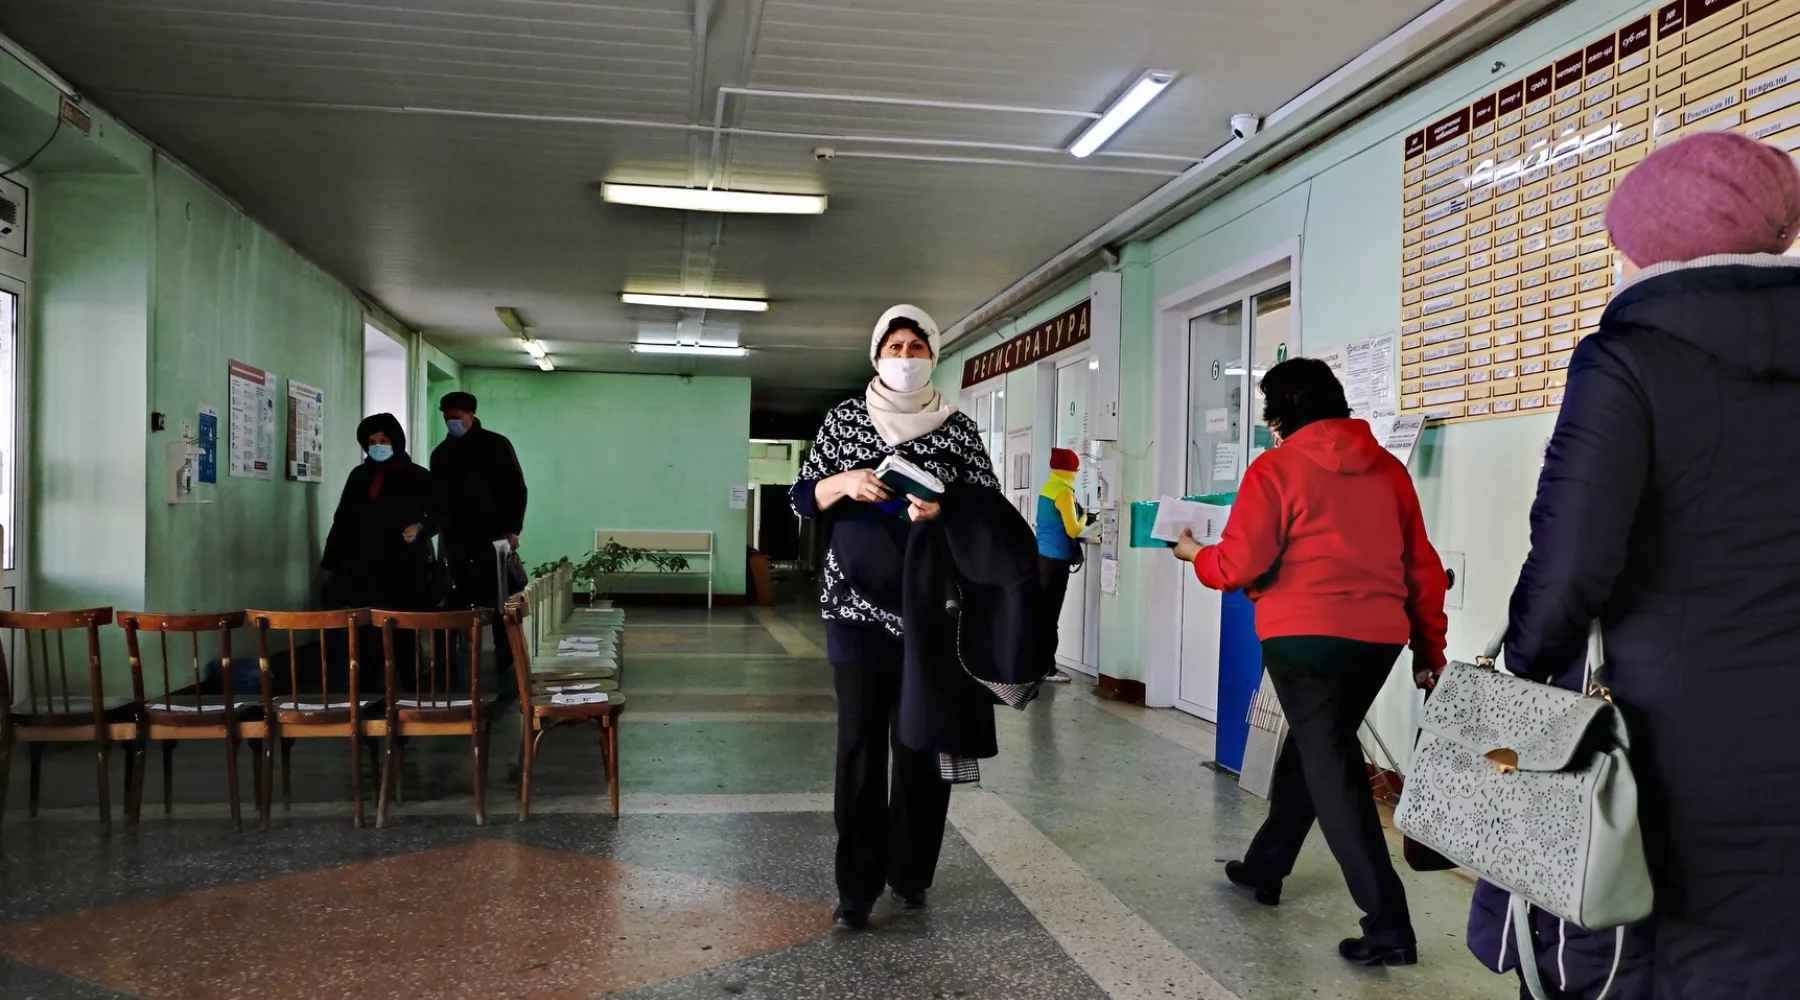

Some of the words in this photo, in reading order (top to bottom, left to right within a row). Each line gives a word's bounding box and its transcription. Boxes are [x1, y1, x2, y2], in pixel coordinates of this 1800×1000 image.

[1622, 28, 1647, 47] суб-та
[1530, 78, 1547, 91] среда
[972, 307, 1087, 381] РЕГИСТРАТУРА
